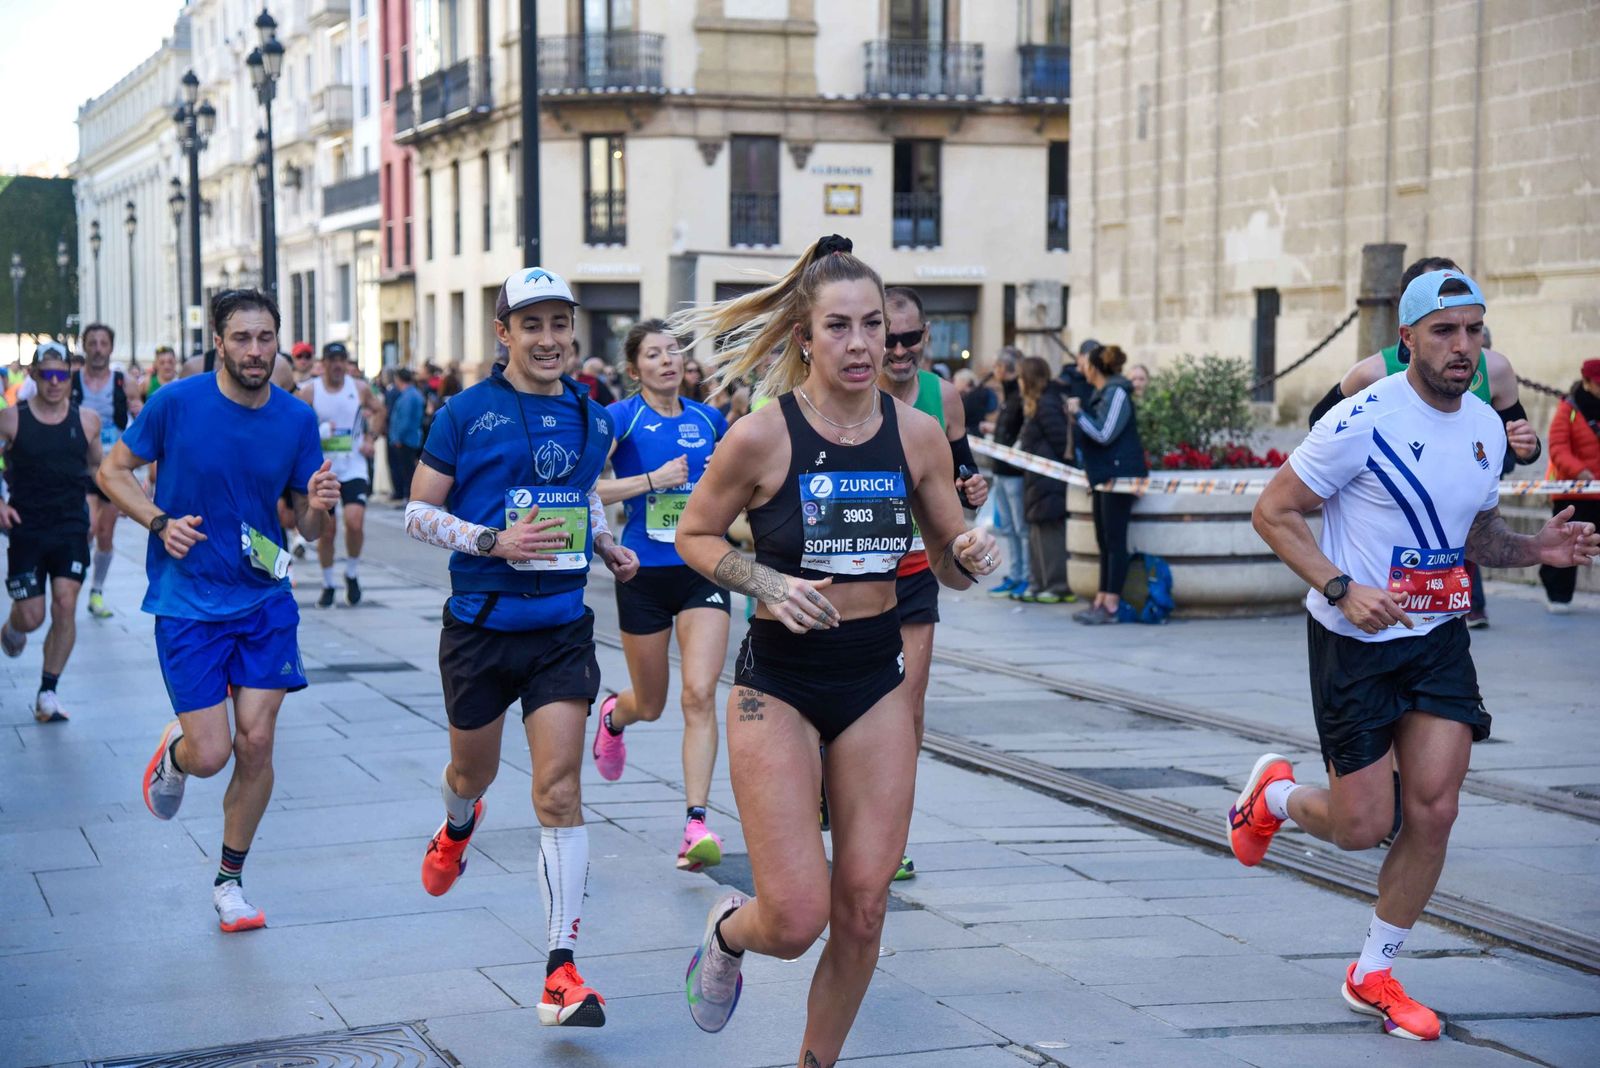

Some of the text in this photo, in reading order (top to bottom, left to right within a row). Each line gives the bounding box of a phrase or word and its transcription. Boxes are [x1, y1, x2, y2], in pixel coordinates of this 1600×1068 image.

[840, 479, 894, 492] ZURICH
[538, 492, 580, 503] ZURICH
[843, 508, 874, 523] 3903
[804, 537, 908, 553] SOPHIE BRADICK
[1427, 552, 1460, 565] ZURICH
[1448, 591, 1471, 609] ISA
